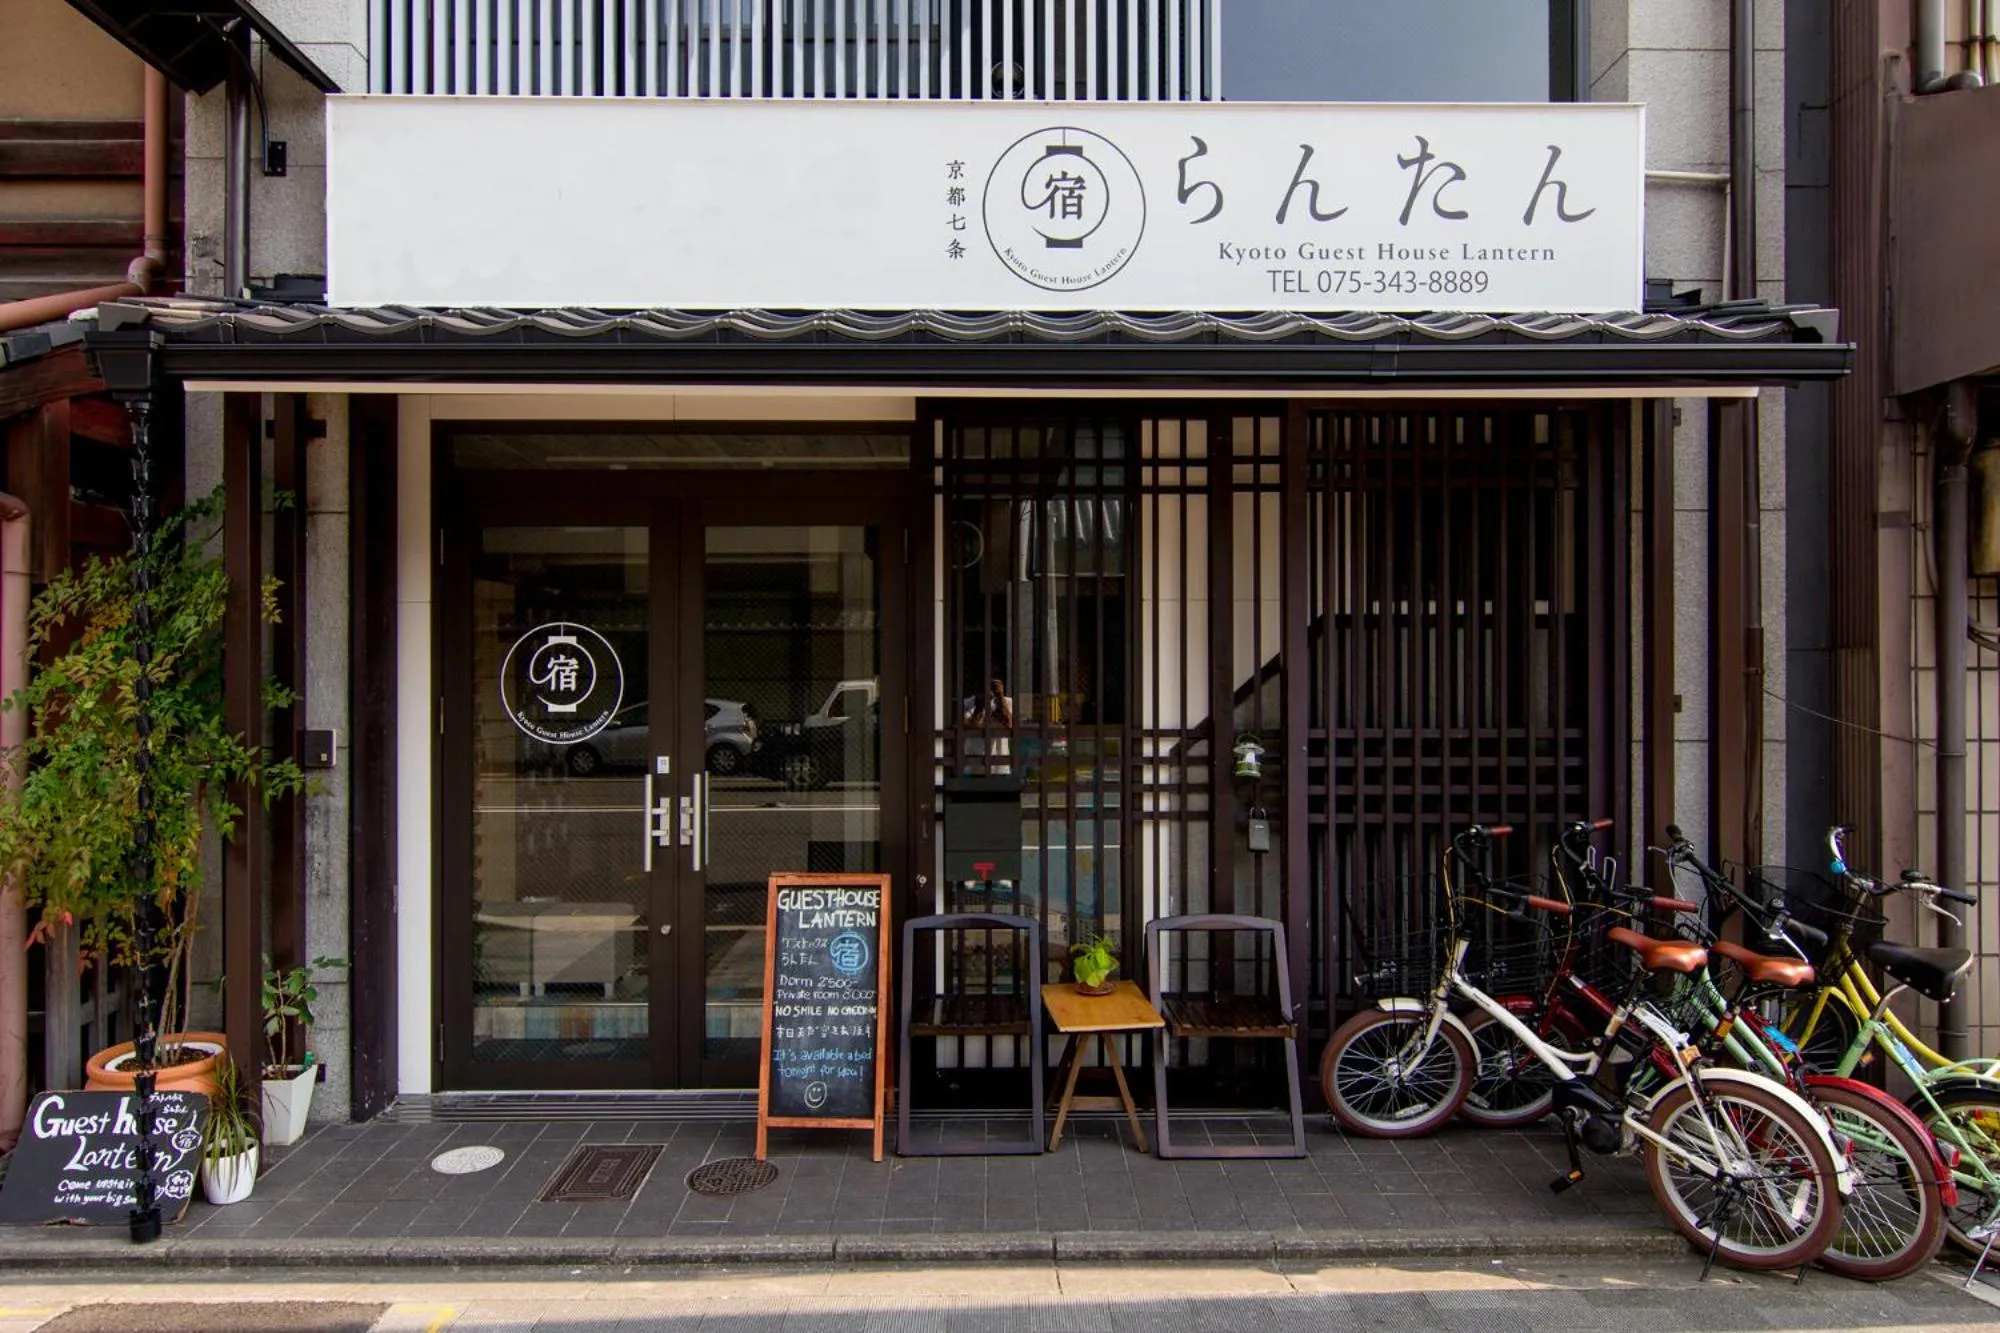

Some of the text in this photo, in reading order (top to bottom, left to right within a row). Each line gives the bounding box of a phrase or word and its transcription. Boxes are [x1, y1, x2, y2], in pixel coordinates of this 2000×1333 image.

[1177, 135, 1597, 226] らんたん
[1044, 170, 1087, 220] 宿
[945, 159, 967, 260] 京都七条
[1219, 242, 1556, 266] Kyoto Guest House Lantern
[1003, 247, 1128, 285] Kyoto Guest House Lantern
[1266, 270, 1489, 293] TEL 075-343-8889
[547, 654, 580, 692] 宿
[778, 888, 880, 912] GUESTHOUSE
[798, 910, 877, 929] LANTERN
[780, 974, 813, 988] Dorm
[777, 989, 810, 1000] Private
[813, 991, 839, 1000] room
[776, 1005, 791, 1017] NO
[793, 1005, 823, 1018] SMILE
[827, 1005, 840, 1017] NO
[773, 1048, 797, 1062] It's
[800, 1048, 845, 1061] available
[854, 1048, 872, 1061] bed
[820, 1064, 833, 1077] for
[33, 1094, 178, 1140] Guest hse
[63, 1135, 184, 1173] Lanten
[58, 1179, 92, 1191] Come
[54, 1193, 81, 1204] with
[83, 1194, 106, 1206] your
[106, 1191, 122, 1207] big
